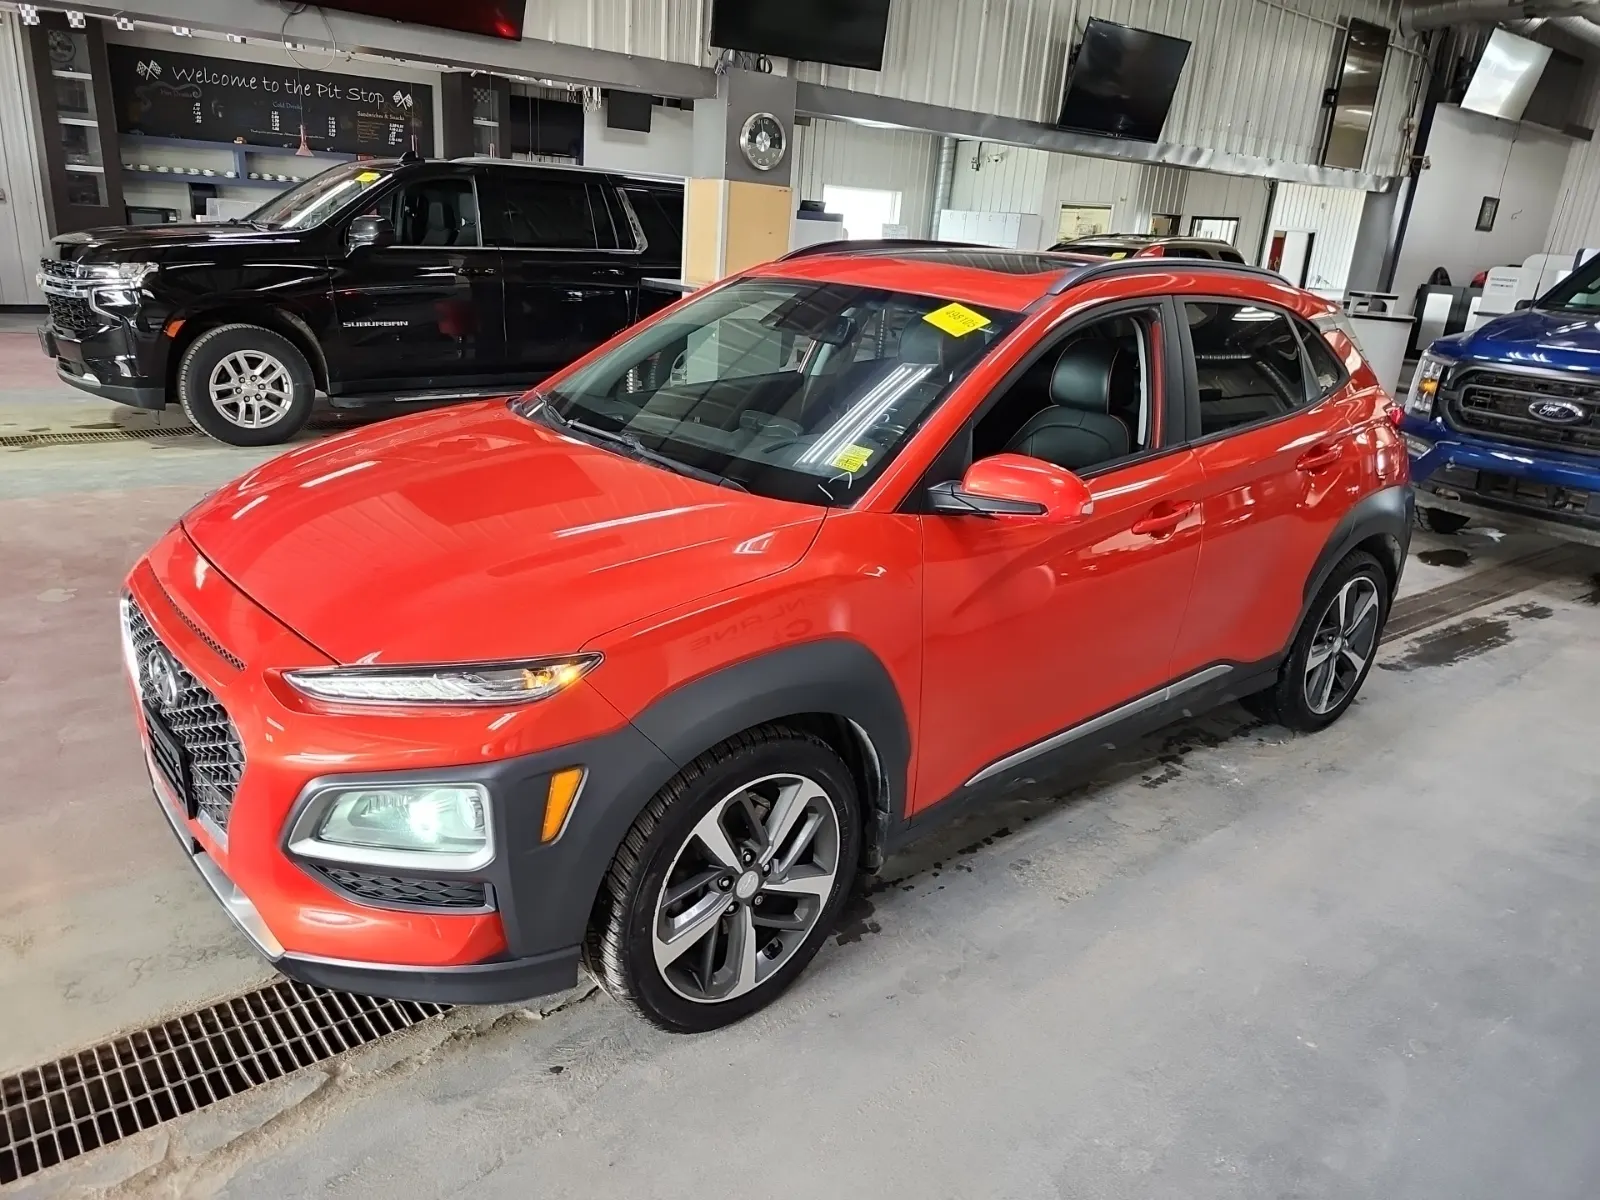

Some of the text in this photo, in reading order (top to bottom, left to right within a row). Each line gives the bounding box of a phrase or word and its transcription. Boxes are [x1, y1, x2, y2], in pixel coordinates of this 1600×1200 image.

[172, 67, 385, 110] Welcome to the Pit Stop
[357, 110, 383, 118] Sandwiches
